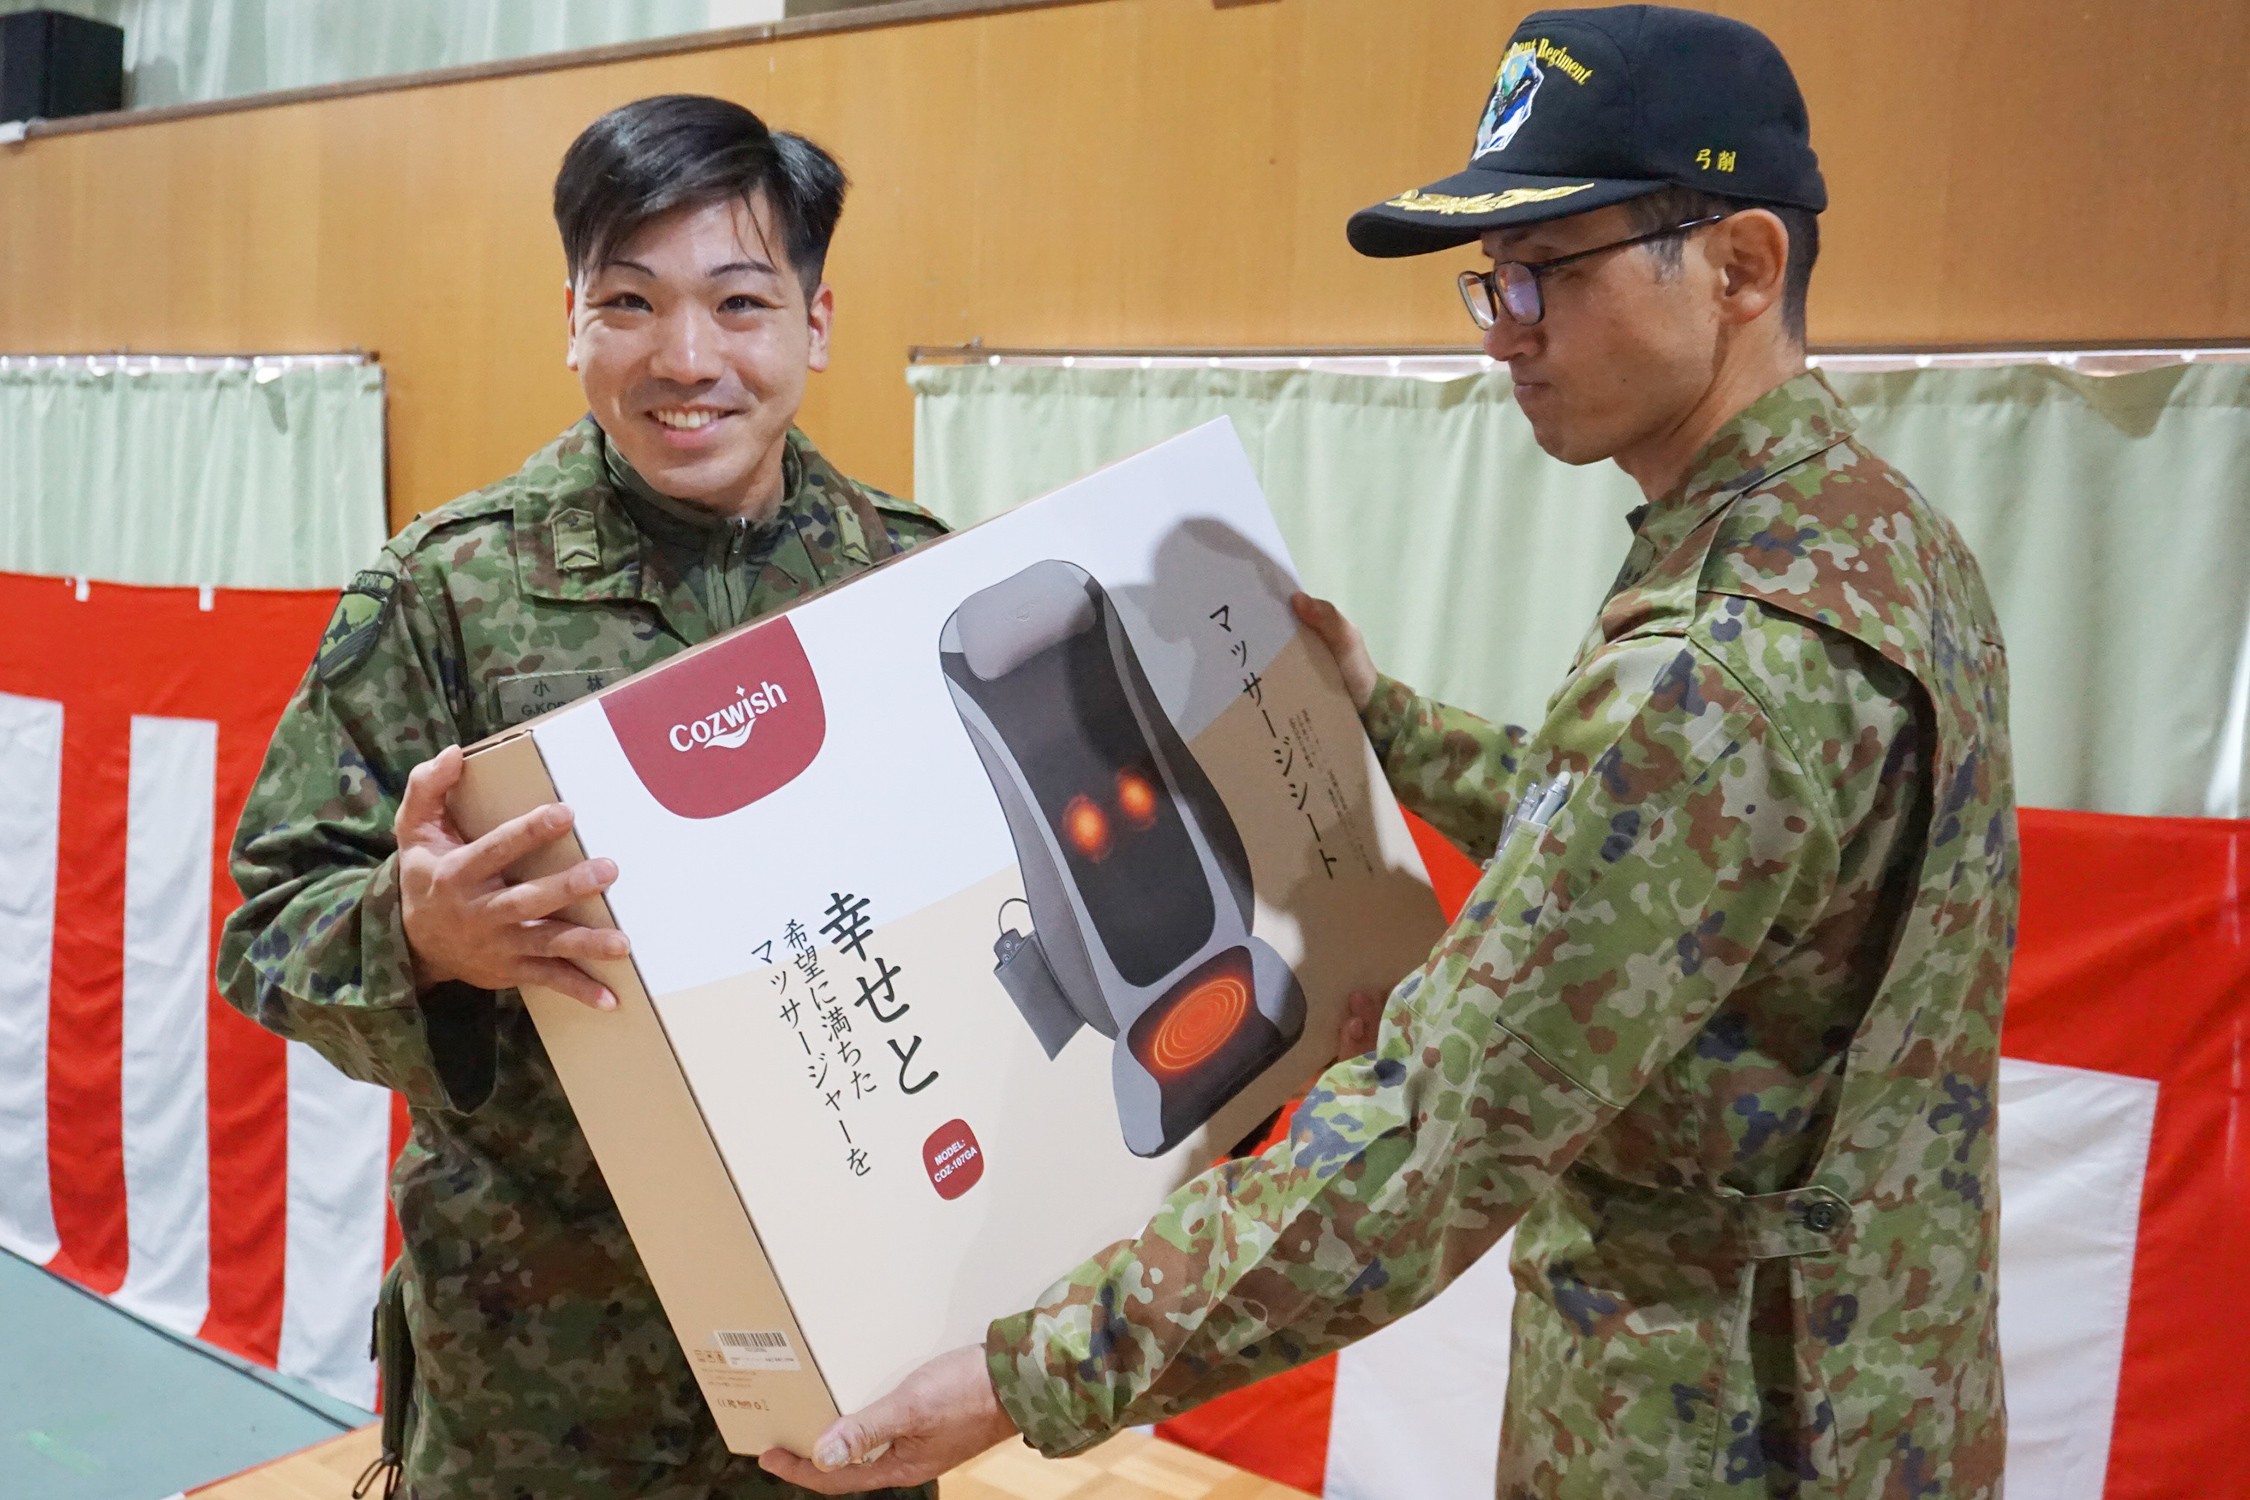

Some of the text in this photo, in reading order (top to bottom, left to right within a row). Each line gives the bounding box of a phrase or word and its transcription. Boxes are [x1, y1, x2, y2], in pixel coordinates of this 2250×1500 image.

[1536, 38, 1593, 86] Regiment
[1695, 148, 1737, 172] 弓削
[669, 680, 788, 753] Cozwish
[1209, 604, 1337, 880] マッサージシート
[783, 918, 877, 1100] 希望に満ちた
[818, 892, 939, 1095] 幸せと
[751, 940, 871, 1177] マッサージャーを
[934, 1139, 966, 1166] MODEL:
